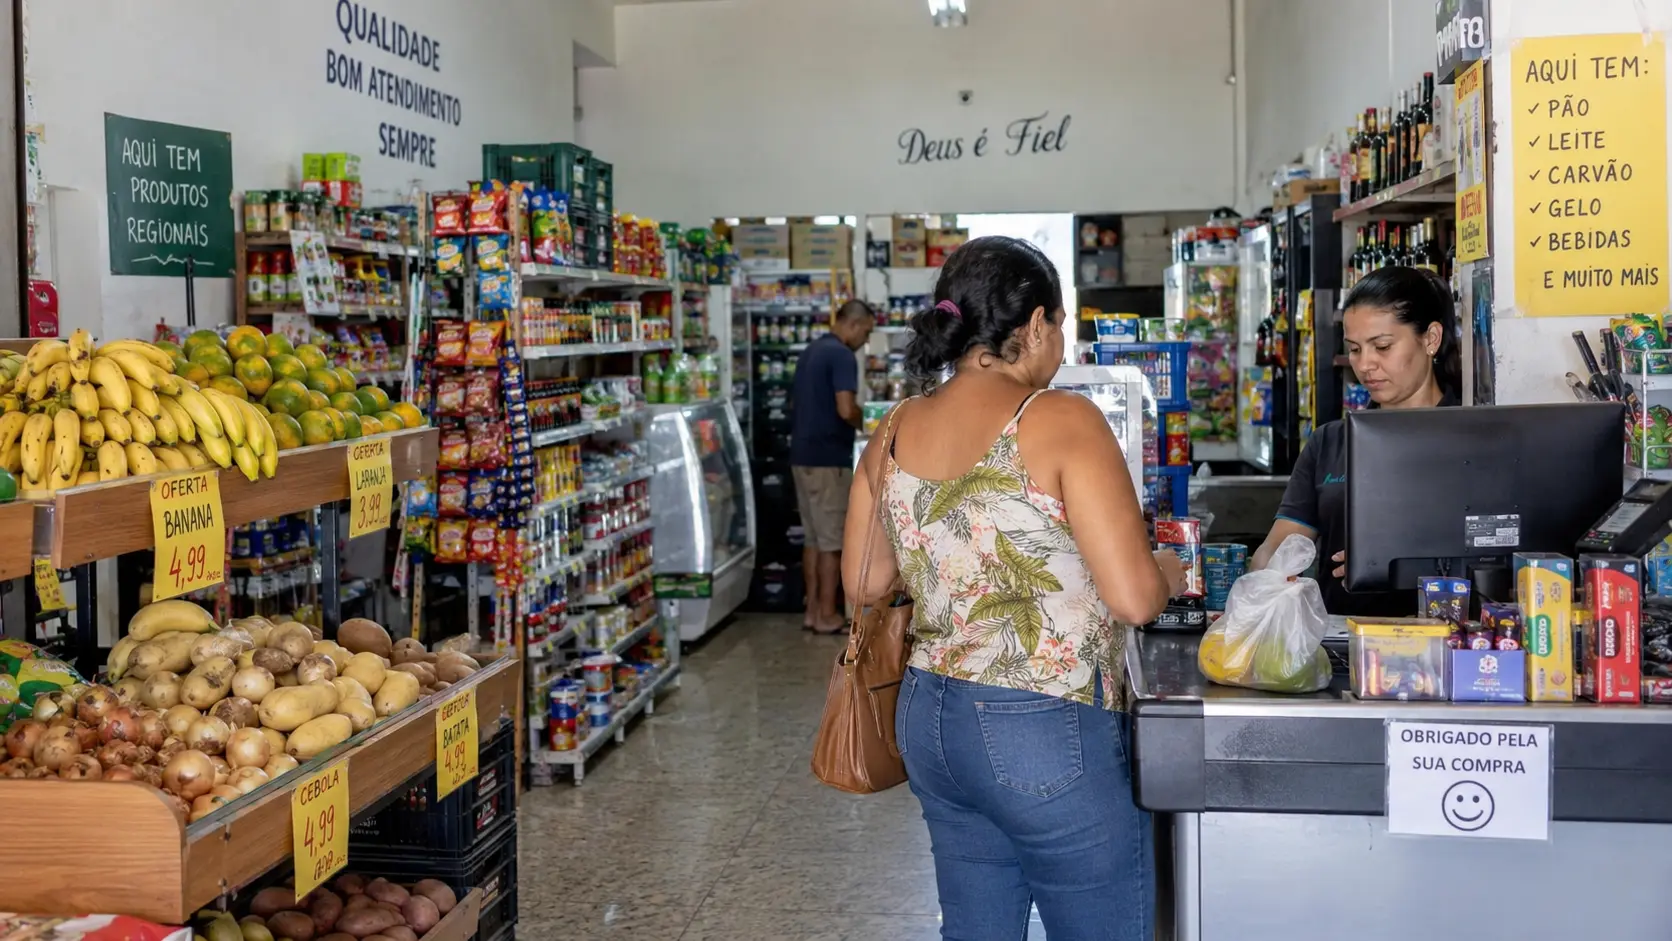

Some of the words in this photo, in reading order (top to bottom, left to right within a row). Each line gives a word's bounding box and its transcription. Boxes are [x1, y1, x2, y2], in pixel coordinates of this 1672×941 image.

[336, 0, 440, 73] QUALIDADE
[1525, 53, 1577, 84] AQUI
[1590, 55, 1649, 80] TEM:
[327, 49, 362, 93] BOM
[368, 66, 462, 127] ATENDIMENTO
[1548, 94, 1590, 118] PÃO
[379, 122, 437, 169] SEMPRE
[898, 128, 964, 165] Deus
[974, 127, 988, 157] é
[1005, 110, 1072, 156] Fiel
[1548, 128, 1606, 151] LEITE
[122, 137, 157, 169] AQUI
[166, 144, 202, 173] TEM
[1548, 158, 1633, 184] CARVÃO
[131, 176, 209, 208] PRODUTOS
[1548, 198, 1602, 218] GELO
[127, 216, 209, 247] REGIONAIS
[1548, 227, 1632, 252] BEBIDAS
[1543, 270, 1554, 290] E
[1563, 265, 1613, 289] MUITO
[1620, 263, 1660, 287] MAIS
[161, 474, 208, 500] OFERTA
[163, 502, 215, 539] BANANA
[169, 544, 206, 591] 4,99
[443, 717, 470, 750] BATATA
[1400, 728, 1492, 746] OBRIGADO
[1497, 732, 1539, 748] PELA
[1412, 755, 1446, 771] SUA
[1451, 757, 1526, 774] COMPRA
[300, 769, 340, 806] CEBOLA
